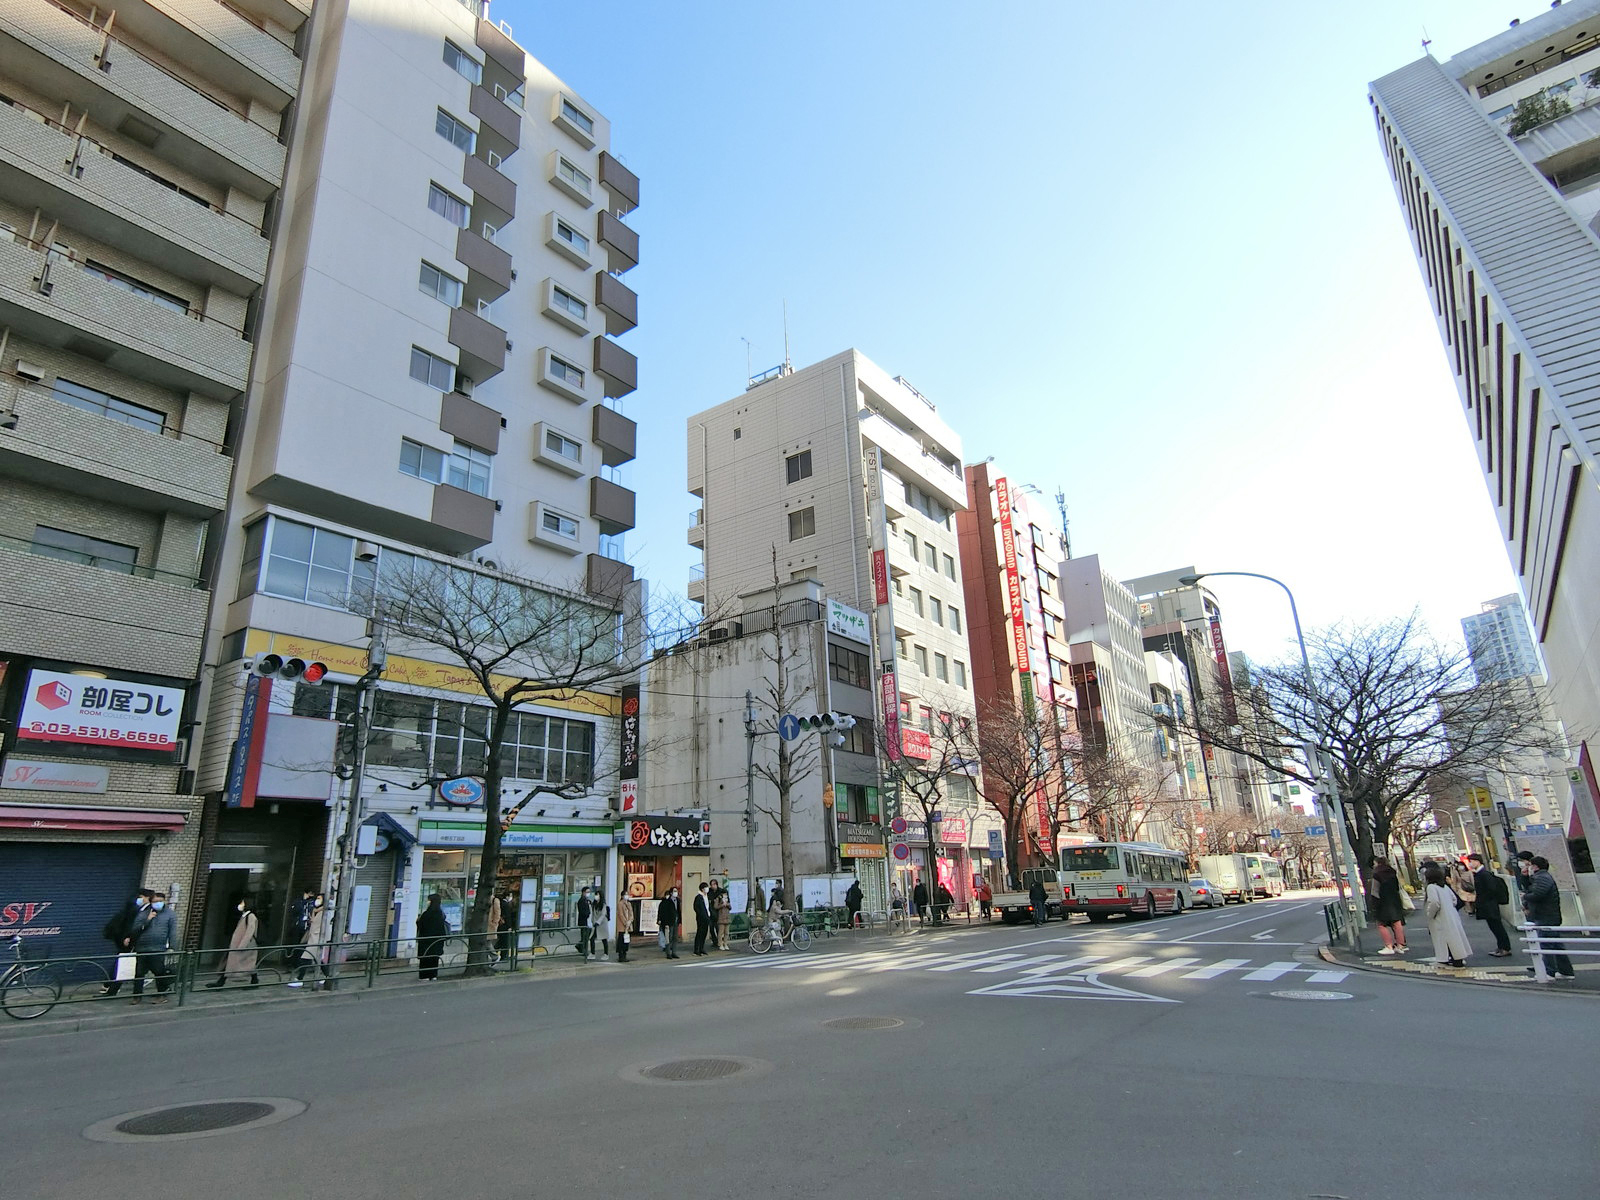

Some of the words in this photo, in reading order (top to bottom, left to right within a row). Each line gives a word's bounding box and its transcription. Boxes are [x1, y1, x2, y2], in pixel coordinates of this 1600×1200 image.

[868, 452, 877, 472] FST
[997, 481, 1009, 521] カラオケ
[1003, 527, 1016, 569] JOYSOUND
[1009, 575, 1022, 617] カラオケ
[833, 611, 865, 631] マツザキ
[1015, 625, 1029, 669] JOYSOUND
[1213, 627, 1224, 656] カラオケ
[311, 649, 333, 662] Home
[336, 657, 358, 667] made
[81, 686, 173, 717] 部屋コレ
[102, 712, 144, 721] COLLECTION
[47, 722, 169, 744] 03-5318-6696
[8, 766, 42, 783] SV
[508, 834, 544, 844] FamilyMart
[990, 832, 998, 842] P
[0, 902, 52, 926] SV
